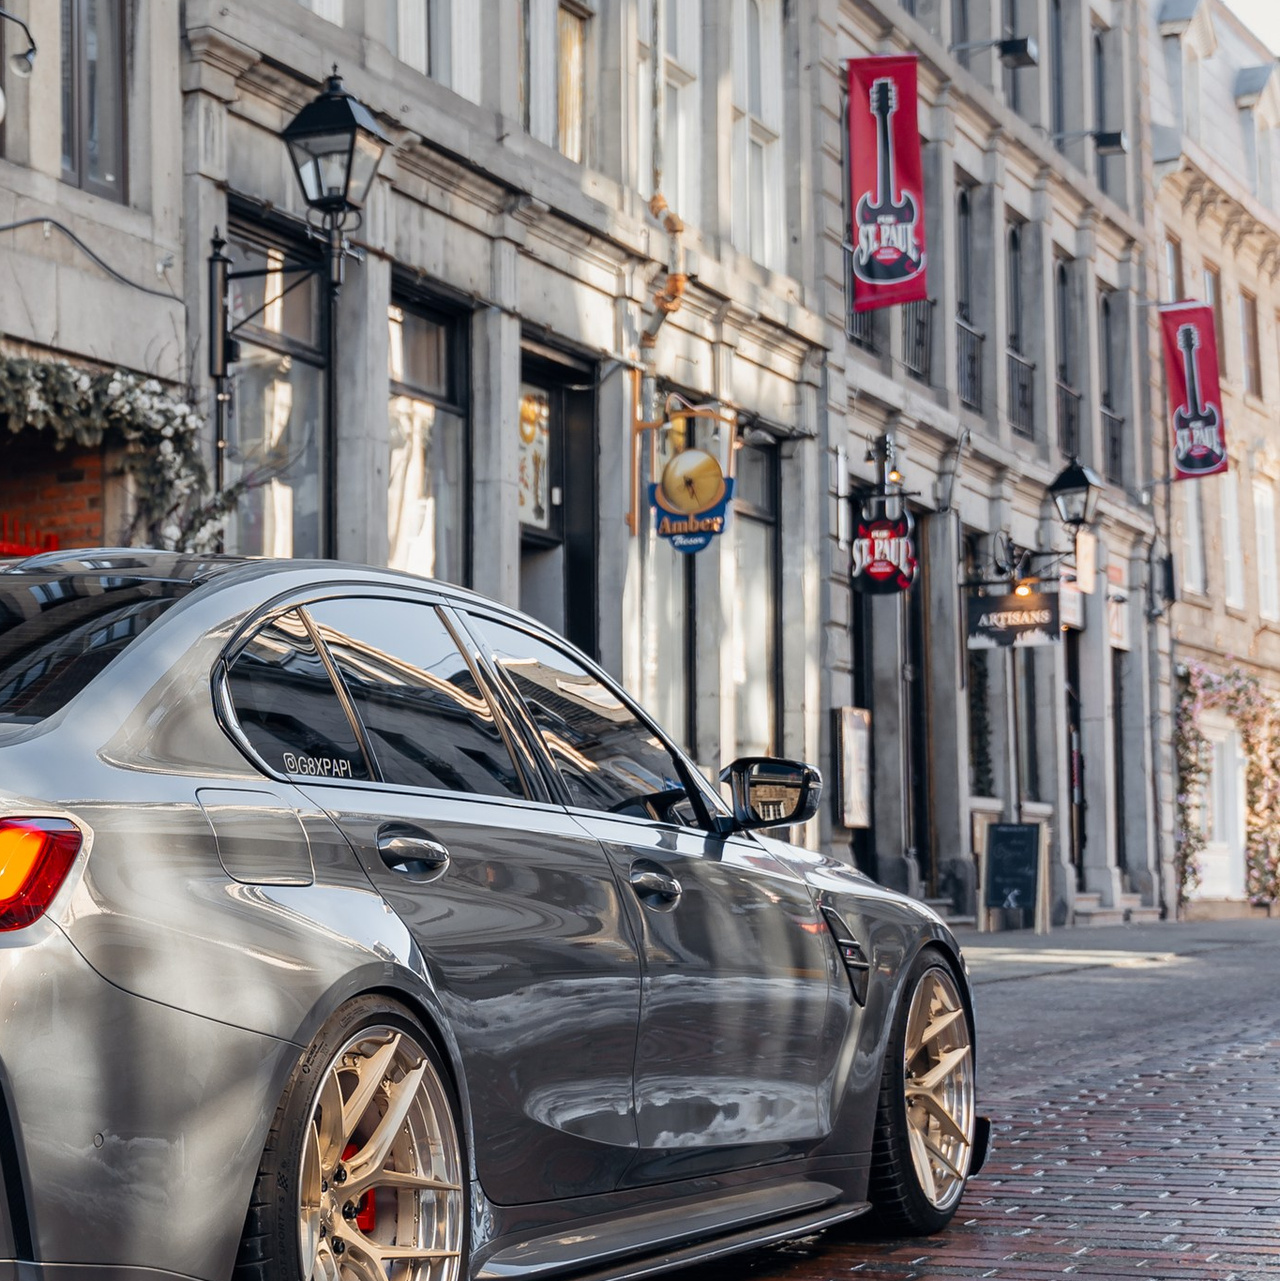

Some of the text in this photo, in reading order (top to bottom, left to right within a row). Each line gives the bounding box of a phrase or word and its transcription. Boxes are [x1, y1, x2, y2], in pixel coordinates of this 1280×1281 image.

[880, 222, 919, 262] PAUL
[1192, 425, 1223, 456] PAUL
[658, 515, 723, 535] Amber
[874, 537, 911, 577] PAUL
[978, 609, 1052, 629] ARTISANS
[277, 1214, 287, 1256] SPORT
